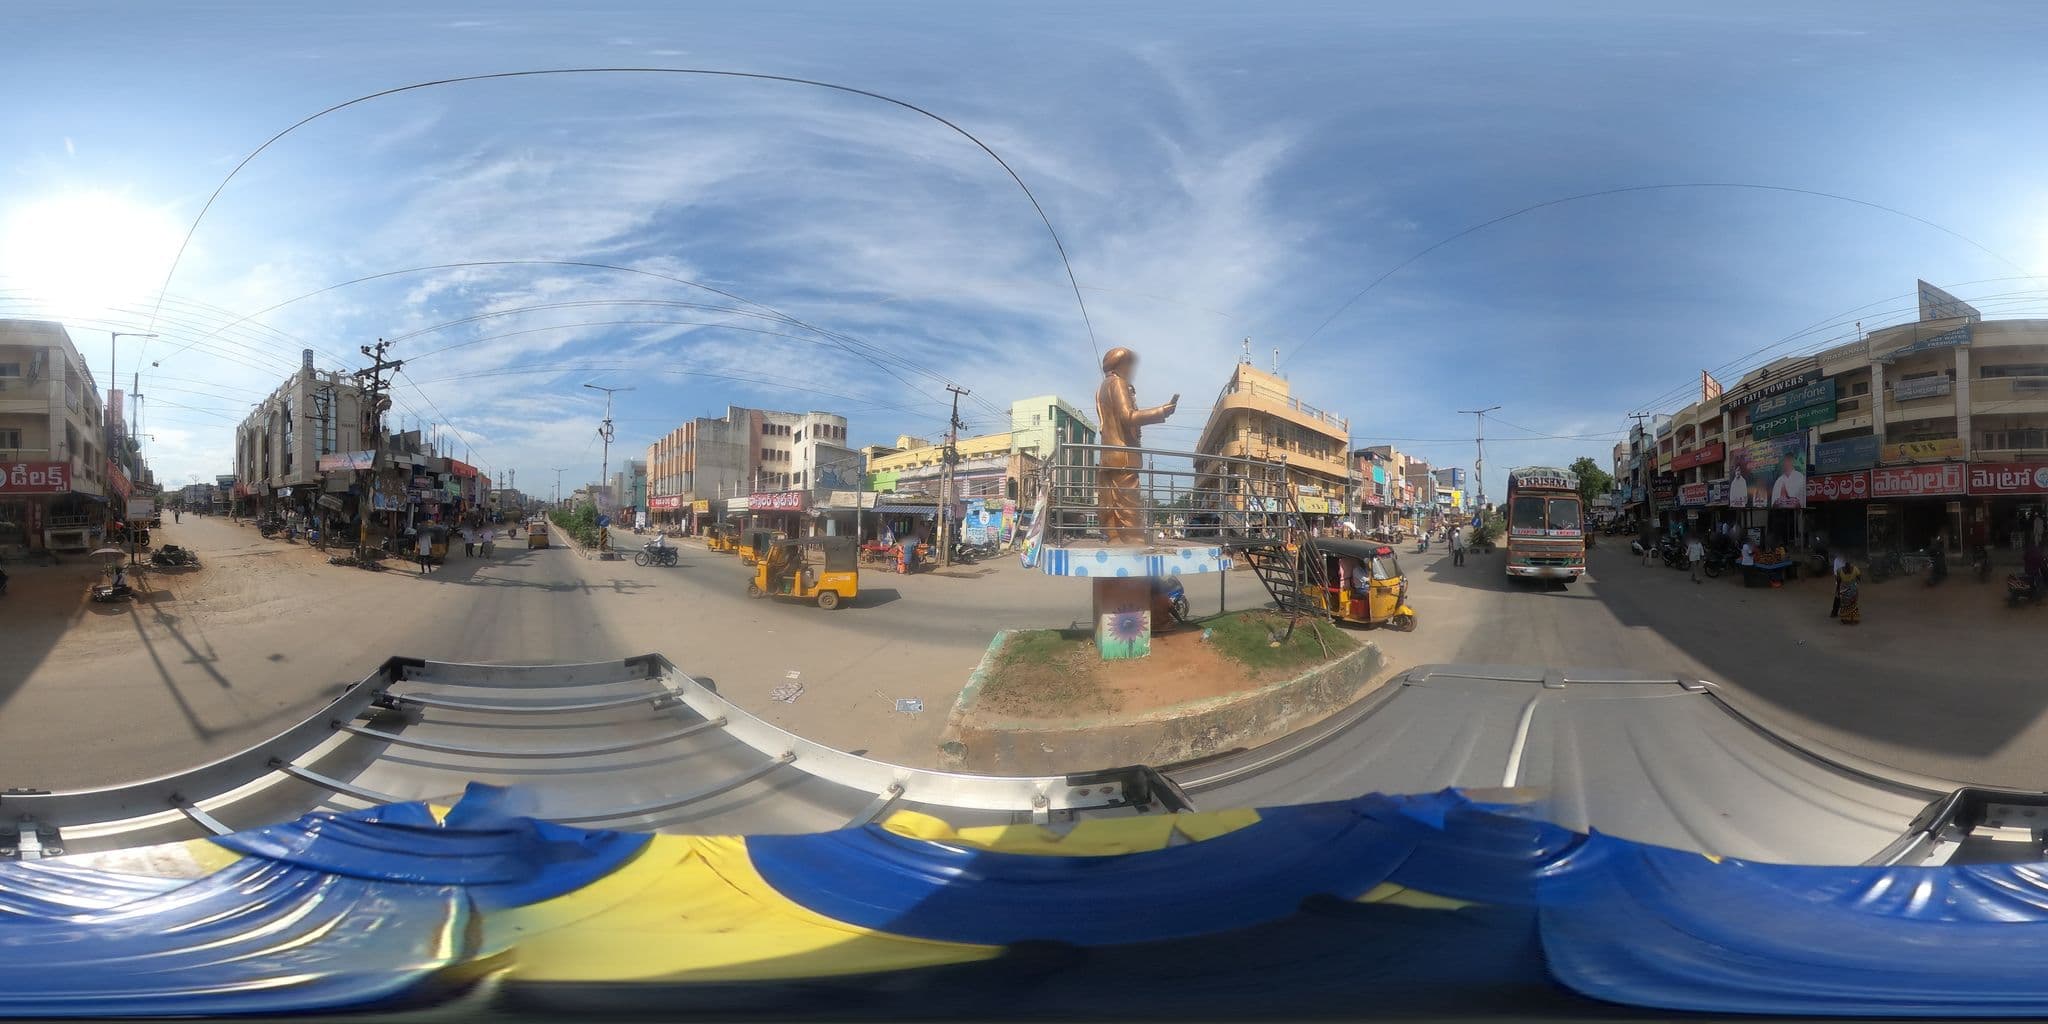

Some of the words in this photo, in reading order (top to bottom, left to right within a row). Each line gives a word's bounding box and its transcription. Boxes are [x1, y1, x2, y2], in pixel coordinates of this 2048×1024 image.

[1728, 399, 1741, 410] SRI
[1763, 375, 1805, 398] TOWERS
[1526, 477, 1568, 488] KRISHNA
